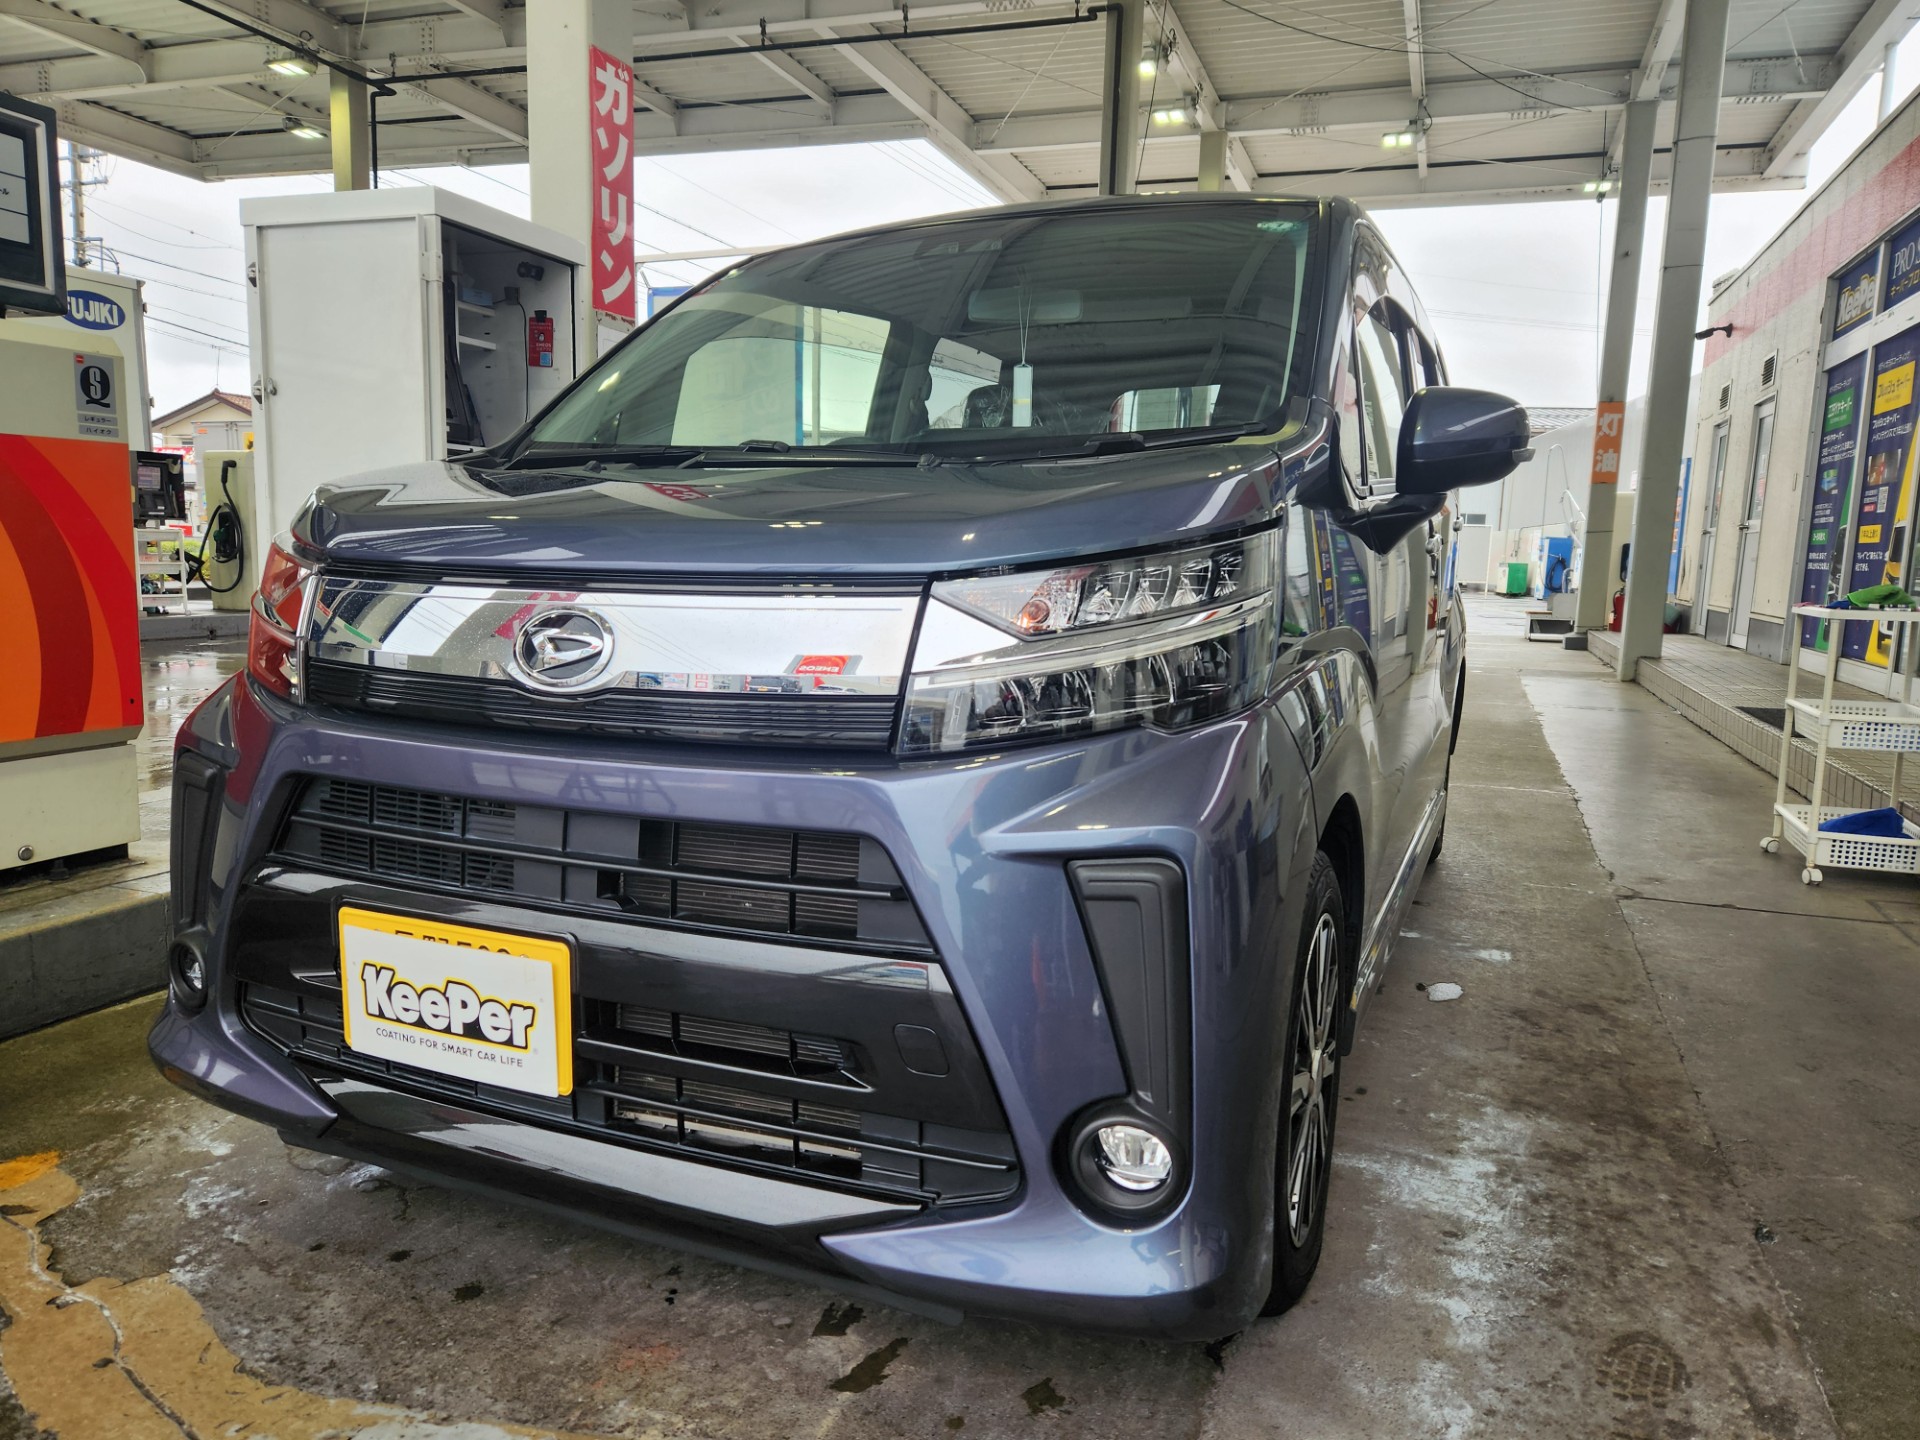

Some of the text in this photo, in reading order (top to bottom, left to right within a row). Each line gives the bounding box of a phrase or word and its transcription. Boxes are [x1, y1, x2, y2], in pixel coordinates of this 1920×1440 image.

[595, 61, 632, 305] ガソリン
[1892, 242, 1916, 280] PRO
[1836, 273, 1877, 328] KeePe
[84, 415, 112, 424] レギュラー
[86, 426, 112, 435] ハイオク
[1595, 412, 1623, 473] 灯油
[361, 962, 536, 1050] KeePer
[375, 1027, 524, 1068] COATING FOR SMART CAR LIFE
